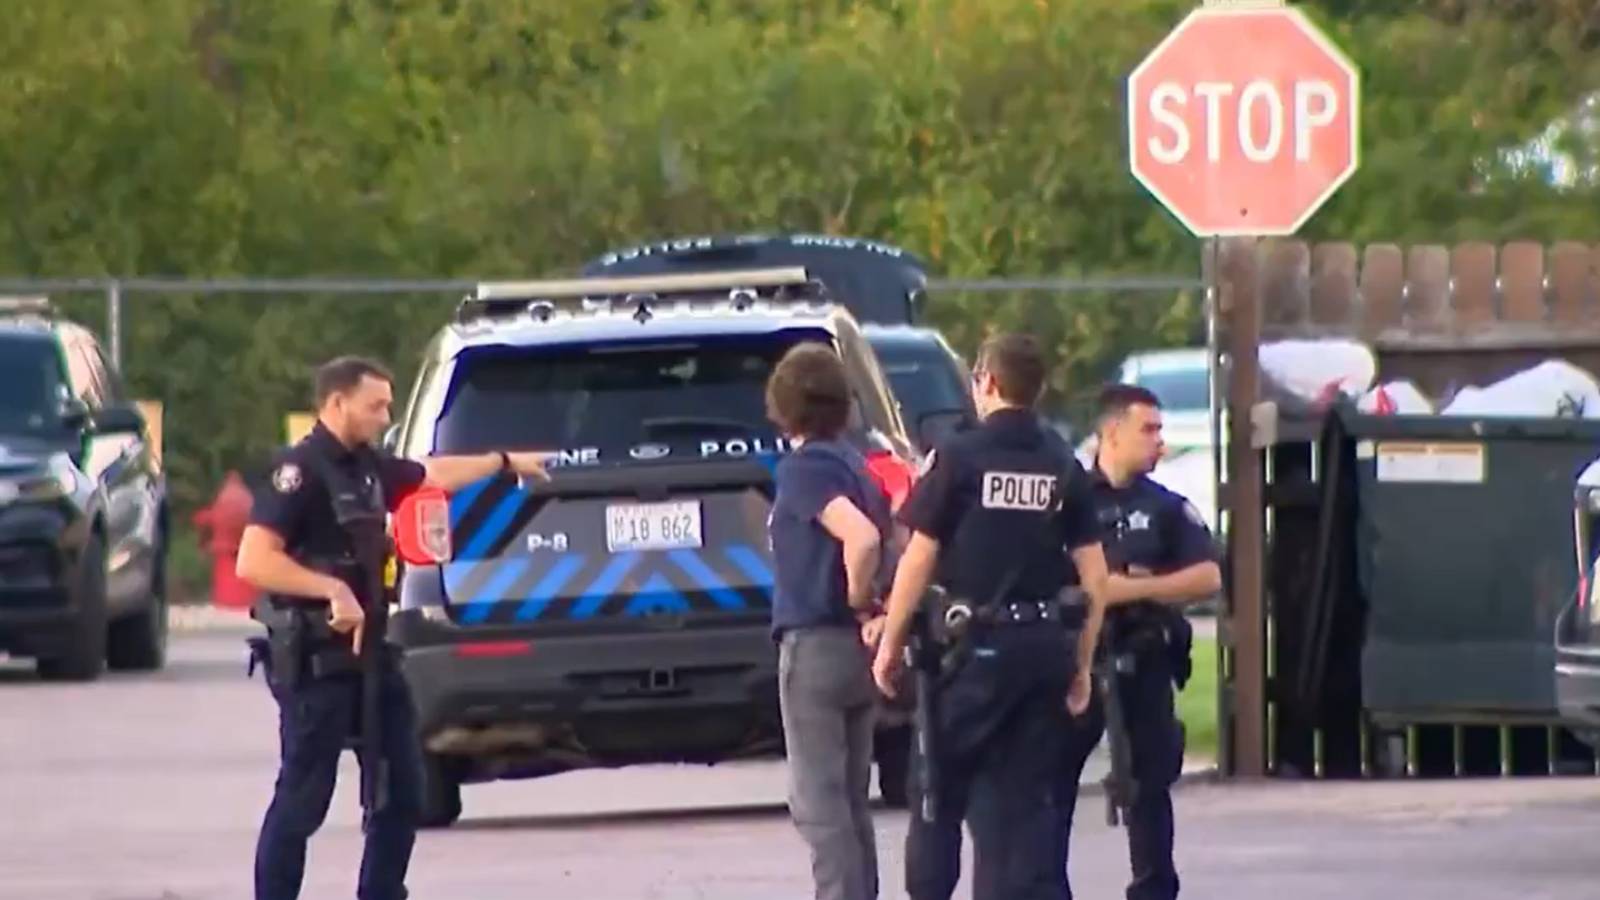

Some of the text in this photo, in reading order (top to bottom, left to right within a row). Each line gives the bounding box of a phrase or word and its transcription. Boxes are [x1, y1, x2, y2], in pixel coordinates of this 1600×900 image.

[1148, 80, 1338, 164] STOP
[701, 438, 788, 459] POLI
[630, 518, 649, 540] 18
[661, 514, 692, 540] 862
